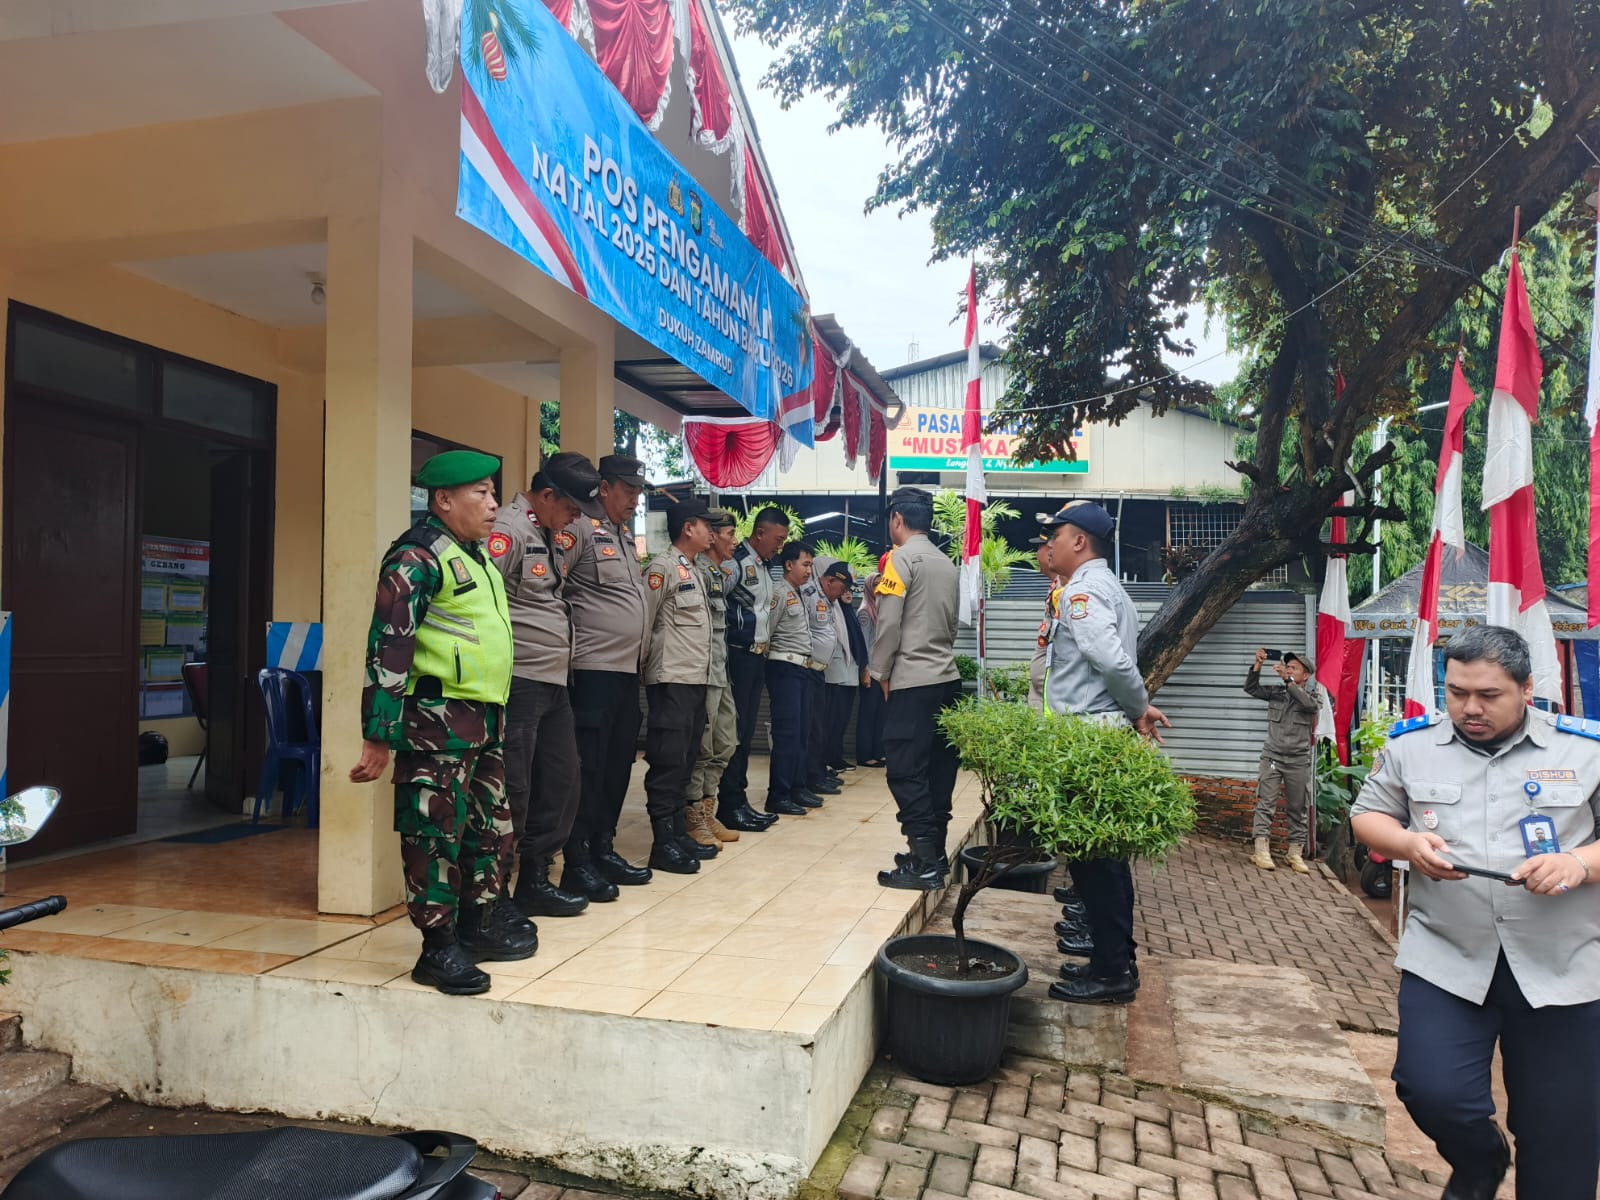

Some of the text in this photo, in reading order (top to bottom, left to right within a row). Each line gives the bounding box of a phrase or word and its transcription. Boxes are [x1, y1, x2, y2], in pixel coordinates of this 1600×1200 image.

[531, 140, 608, 238] NATAL
[611, 213, 656, 276] 2025
[659, 254, 692, 308] DAN
[694, 286, 740, 345] TAHUN
[583, 133, 774, 341] POS PENGAMANAN
[659, 307, 733, 376] DUKUH ZAMRUD
[917, 413, 965, 434] PASA
[1353, 619, 1376, 631] We
[1379, 619, 1407, 631] Cut
[1529, 770, 1577, 780] DISHUB
